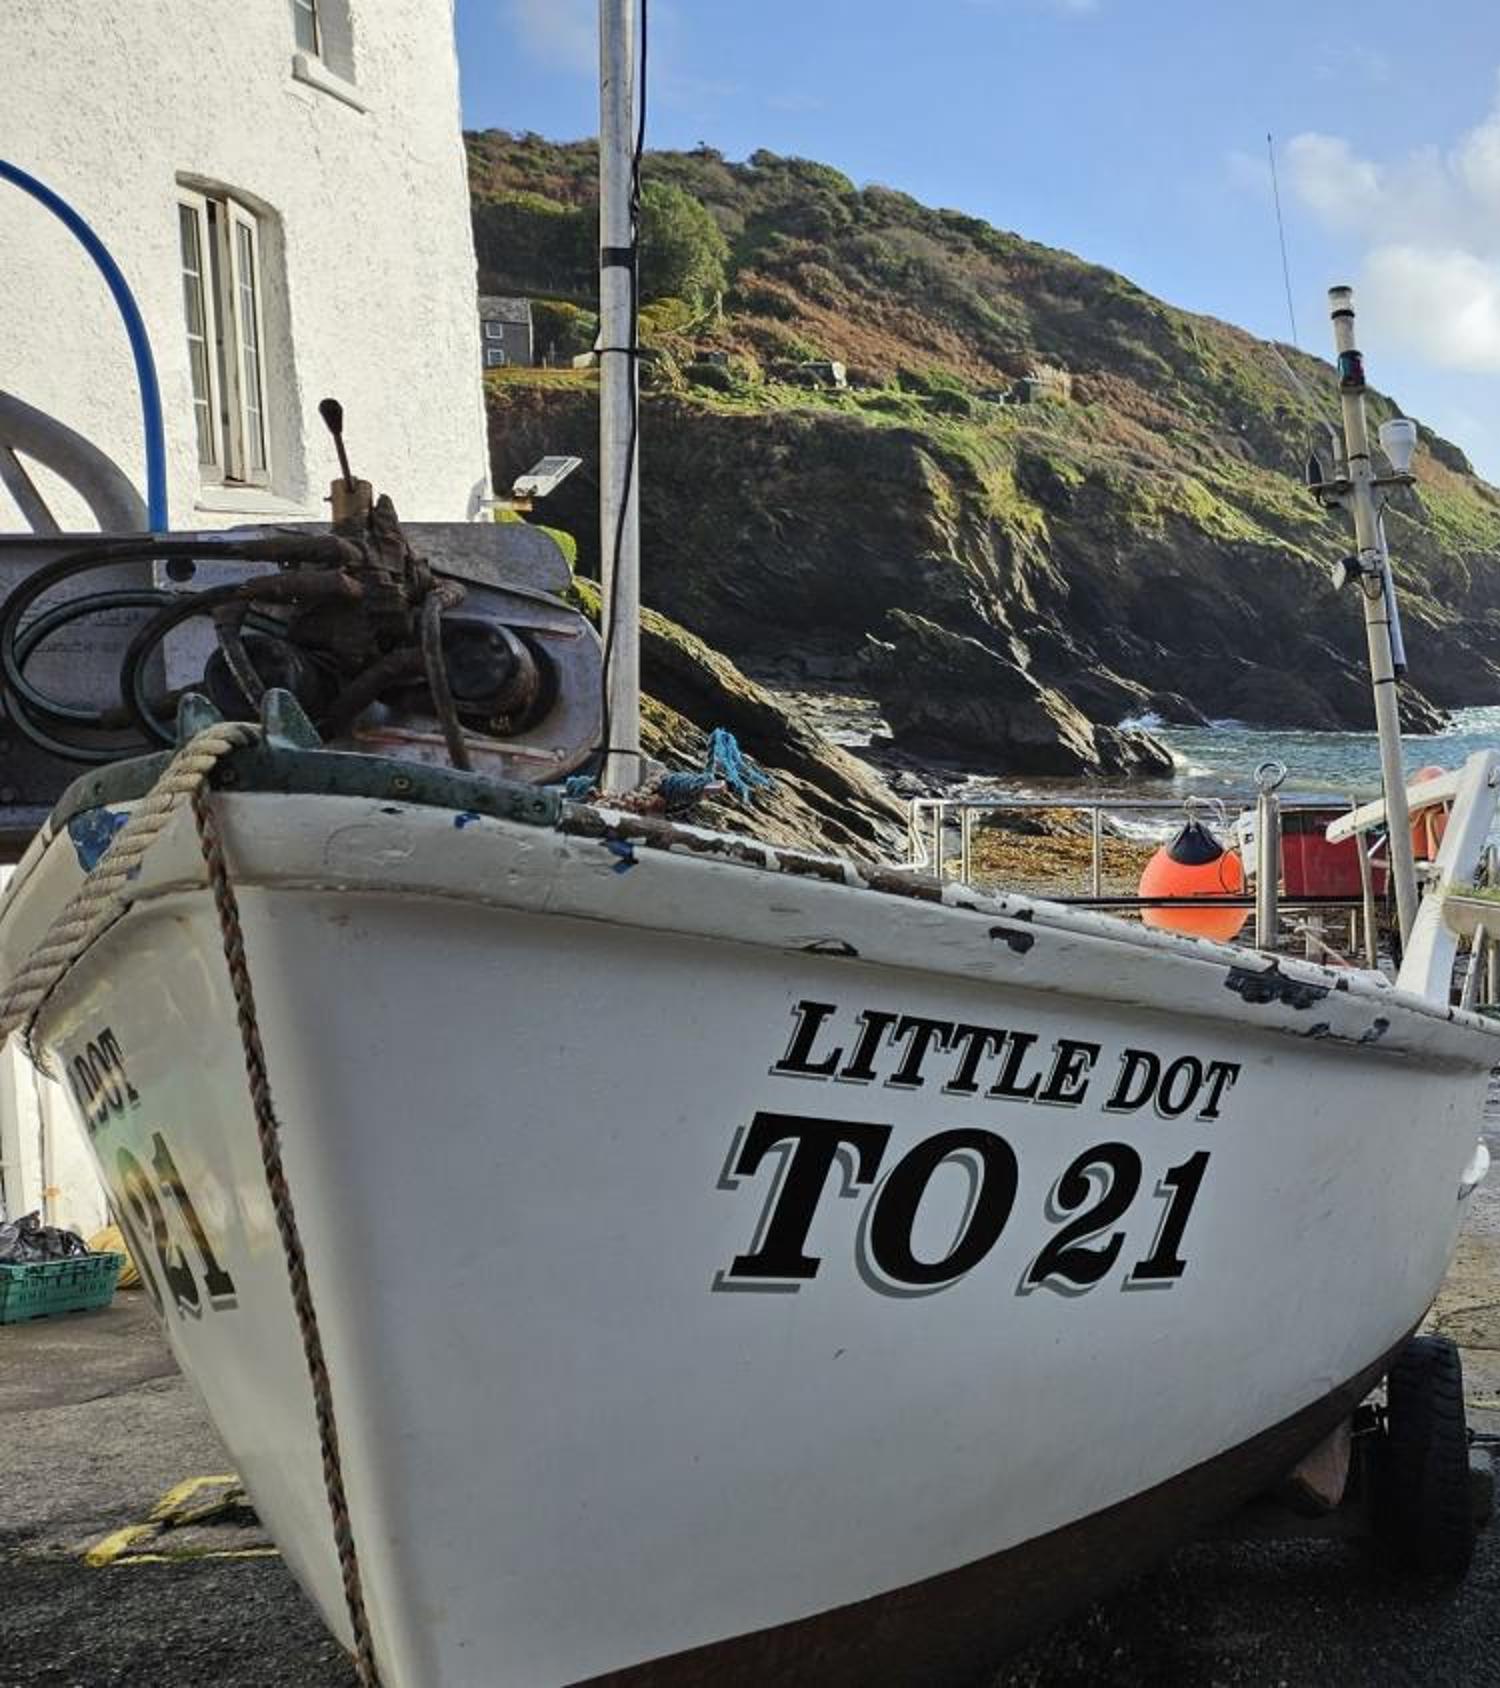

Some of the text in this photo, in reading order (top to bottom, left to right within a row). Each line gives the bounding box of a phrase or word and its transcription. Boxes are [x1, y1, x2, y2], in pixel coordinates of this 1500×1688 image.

[769, 999, 1241, 1122] LITTLE DOT
[711, 1111, 1211, 1300] TO 21
